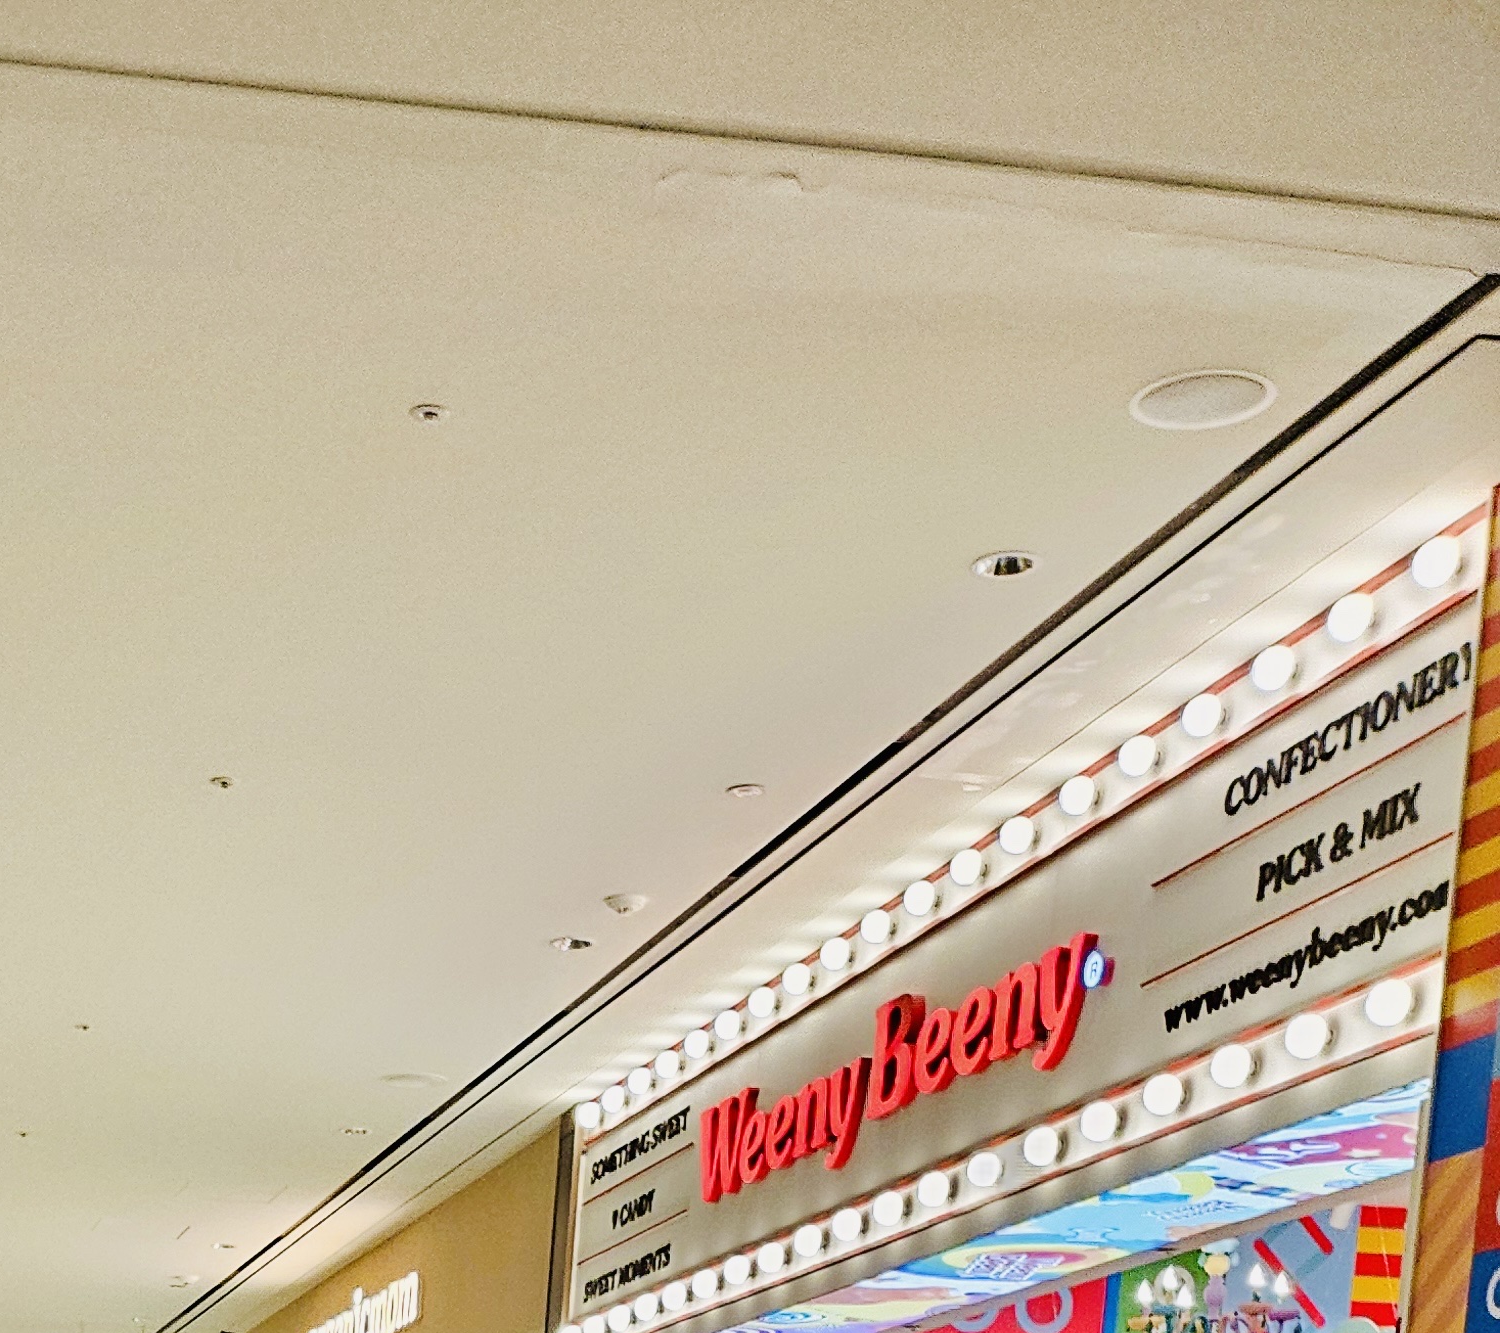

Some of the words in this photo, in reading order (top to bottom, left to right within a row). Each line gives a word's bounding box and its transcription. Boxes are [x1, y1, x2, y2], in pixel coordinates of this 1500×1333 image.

[1256, 833, 1325, 901] PICK
[1330, 822, 1354, 862] &
[1360, 783, 1422, 848] MIX
[591, 1130, 650, 1184] SOMETHING
[650, 1105, 690, 1150] SWEET
[701, 1057, 871, 1204] Weeny
[619, 1189, 655, 1227] CANDY
[583, 1269, 617, 1303] SWEET
[618, 1243, 671, 1288] MOMENTS
